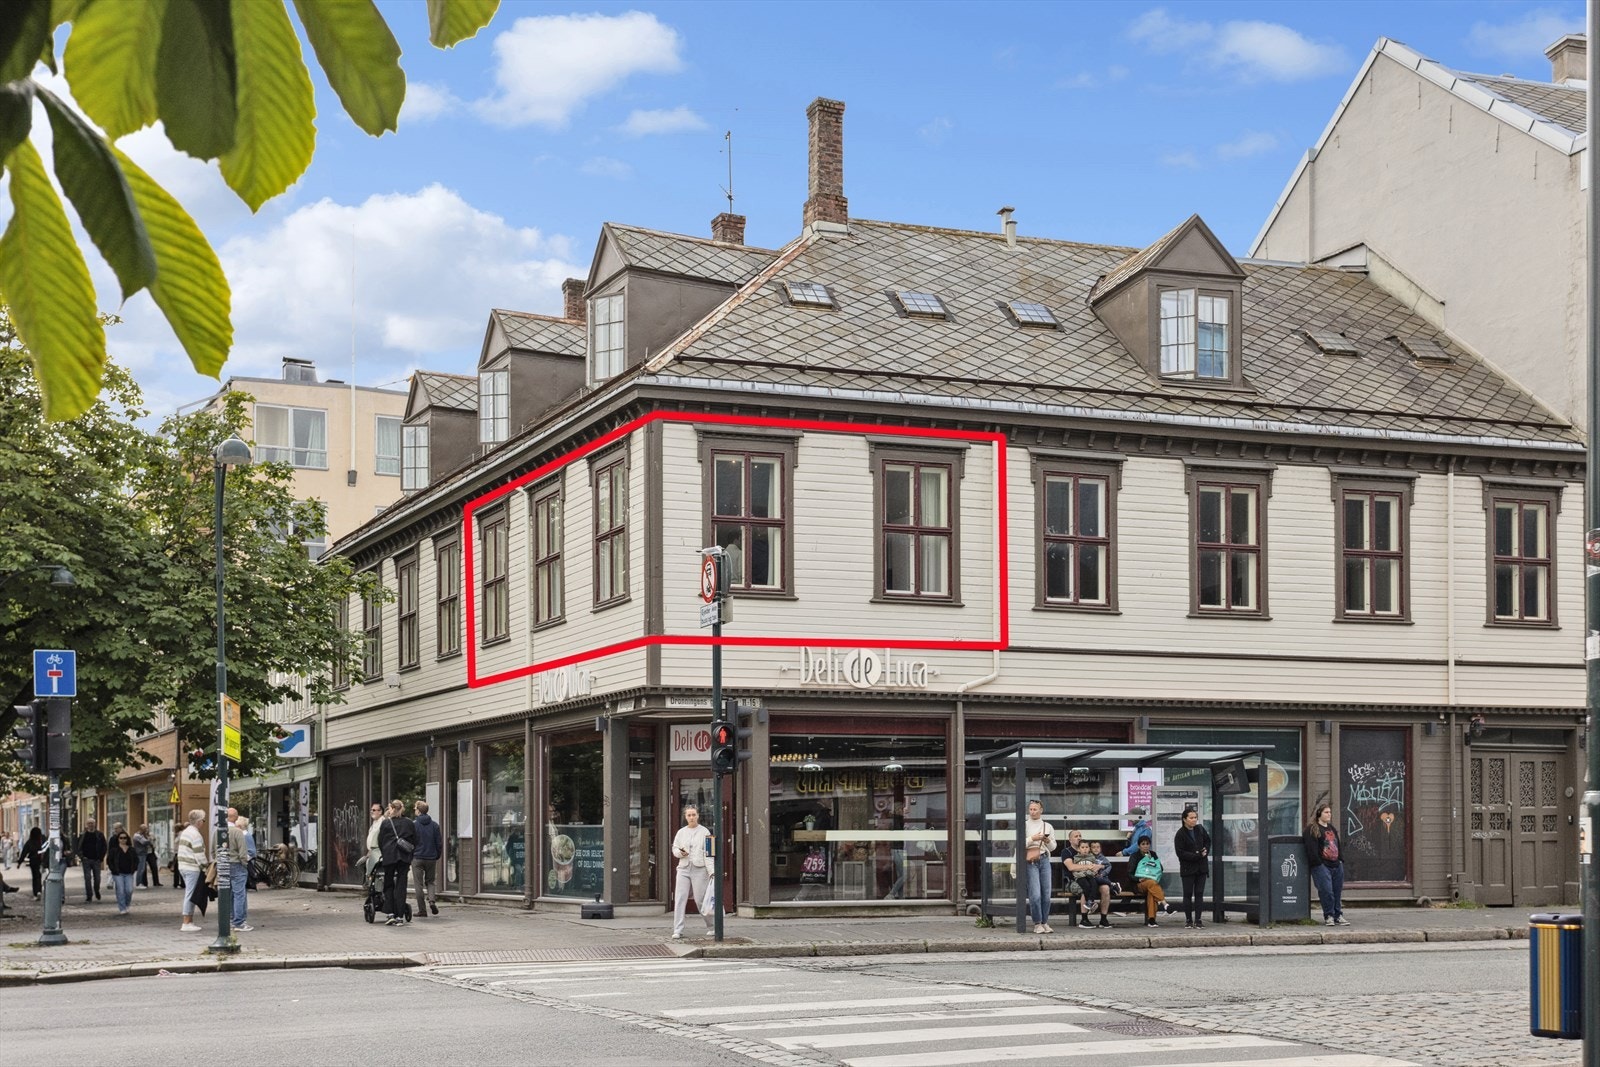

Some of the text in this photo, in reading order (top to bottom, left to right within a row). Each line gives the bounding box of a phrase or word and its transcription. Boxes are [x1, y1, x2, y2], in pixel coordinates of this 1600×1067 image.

[800, 647, 839, 685] Deli
[885, 648, 928, 687] Luca
[670, 696, 708, 707] Dronningens
[674, 730, 710, 752] Deli de
